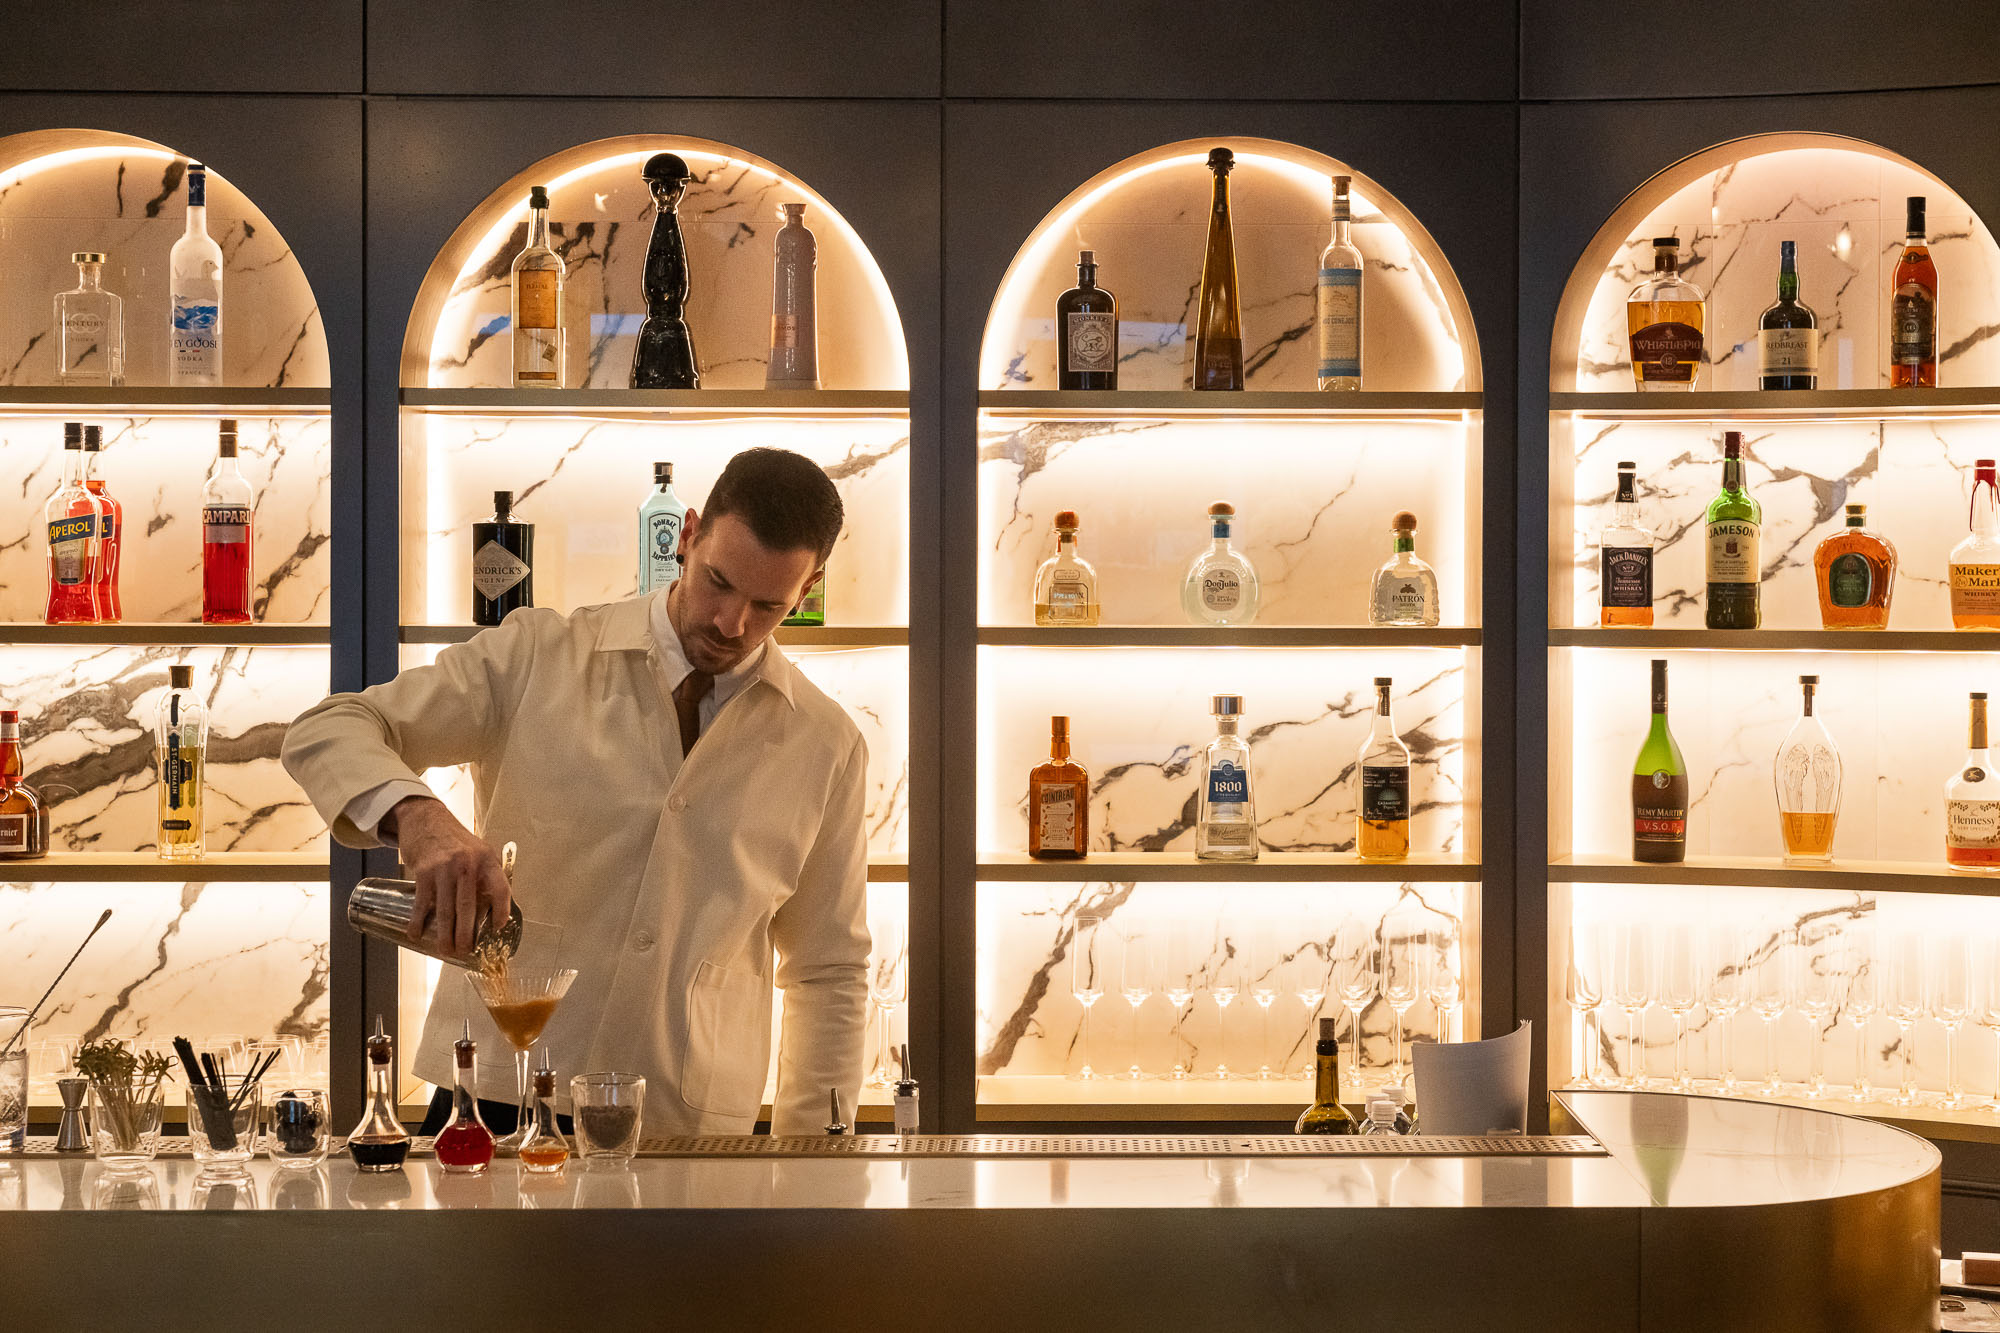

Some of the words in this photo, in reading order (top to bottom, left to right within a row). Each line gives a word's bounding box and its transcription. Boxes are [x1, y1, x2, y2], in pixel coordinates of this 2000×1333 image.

[1766, 341, 1808, 349] REDBREAST
[1782, 357, 1791, 365] 21
[653, 519, 677, 529] BOMBAY
[50, 521, 91, 540] APEROL
[1709, 525, 1754, 539] JAMESON
[474, 566, 522, 575] ENDRICK'S
[1214, 781, 1242, 792] 1800
[1953, 815, 1995, 827] Hennessy
